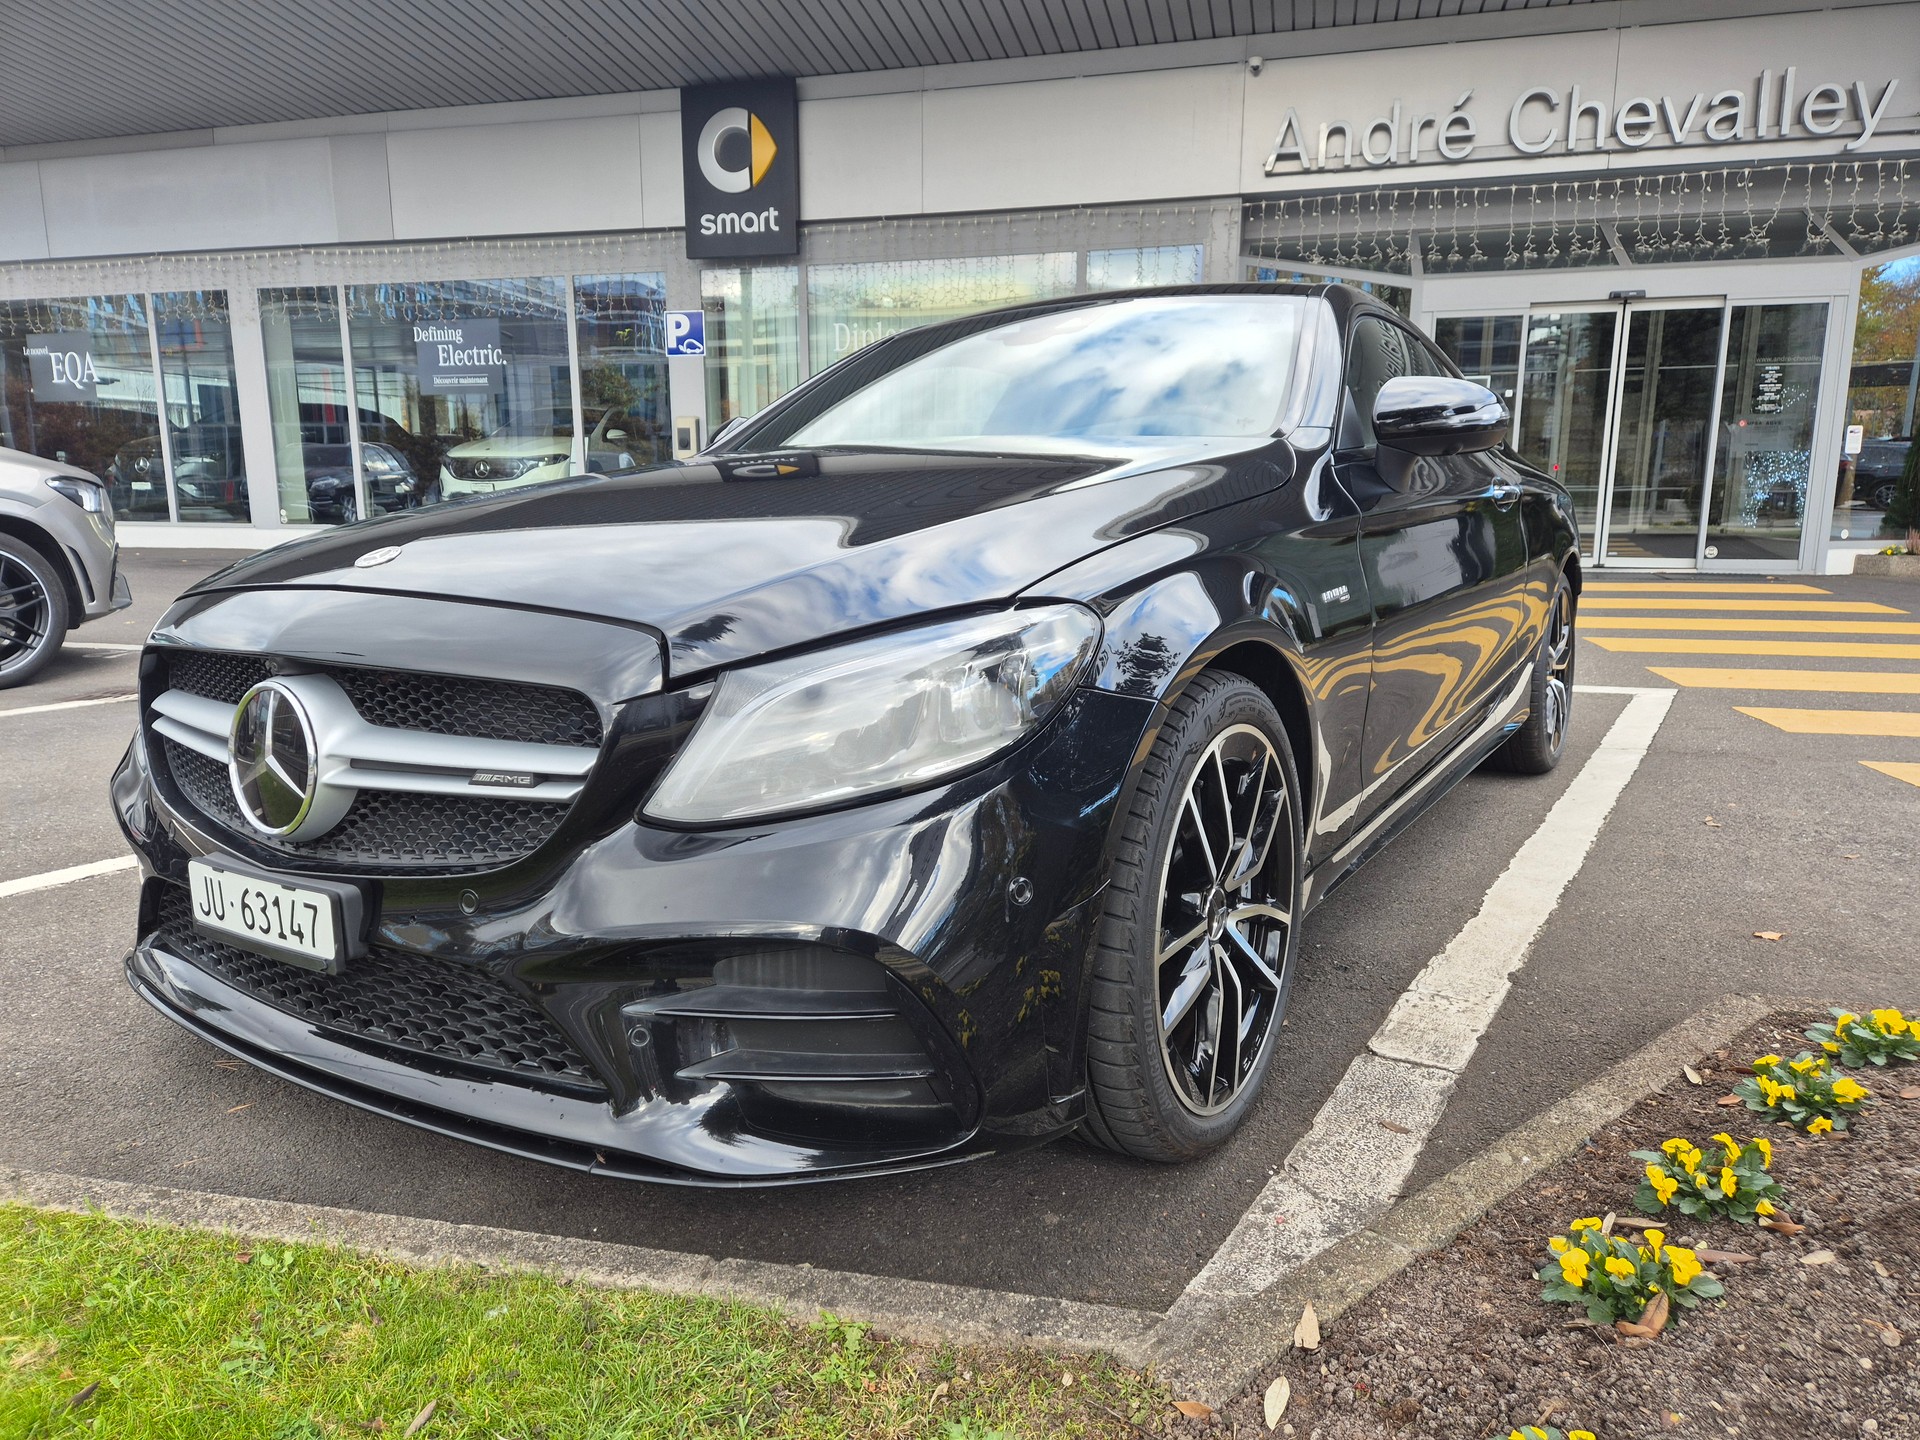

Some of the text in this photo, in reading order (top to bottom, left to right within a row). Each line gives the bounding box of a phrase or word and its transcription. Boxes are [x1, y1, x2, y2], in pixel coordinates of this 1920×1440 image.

[1263, 66, 1900, 172] André Chevalley
[700, 206, 780, 235] smart
[412, 326, 464, 344] Defining
[666, 313, 691, 348] P
[30, 345, 49, 355] nouvel
[437, 343, 508, 366] Electric.
[49, 351, 100, 390] EQA
[433, 375, 488, 385] Découvrir maintenant
[490, 773, 531, 785] AMG
